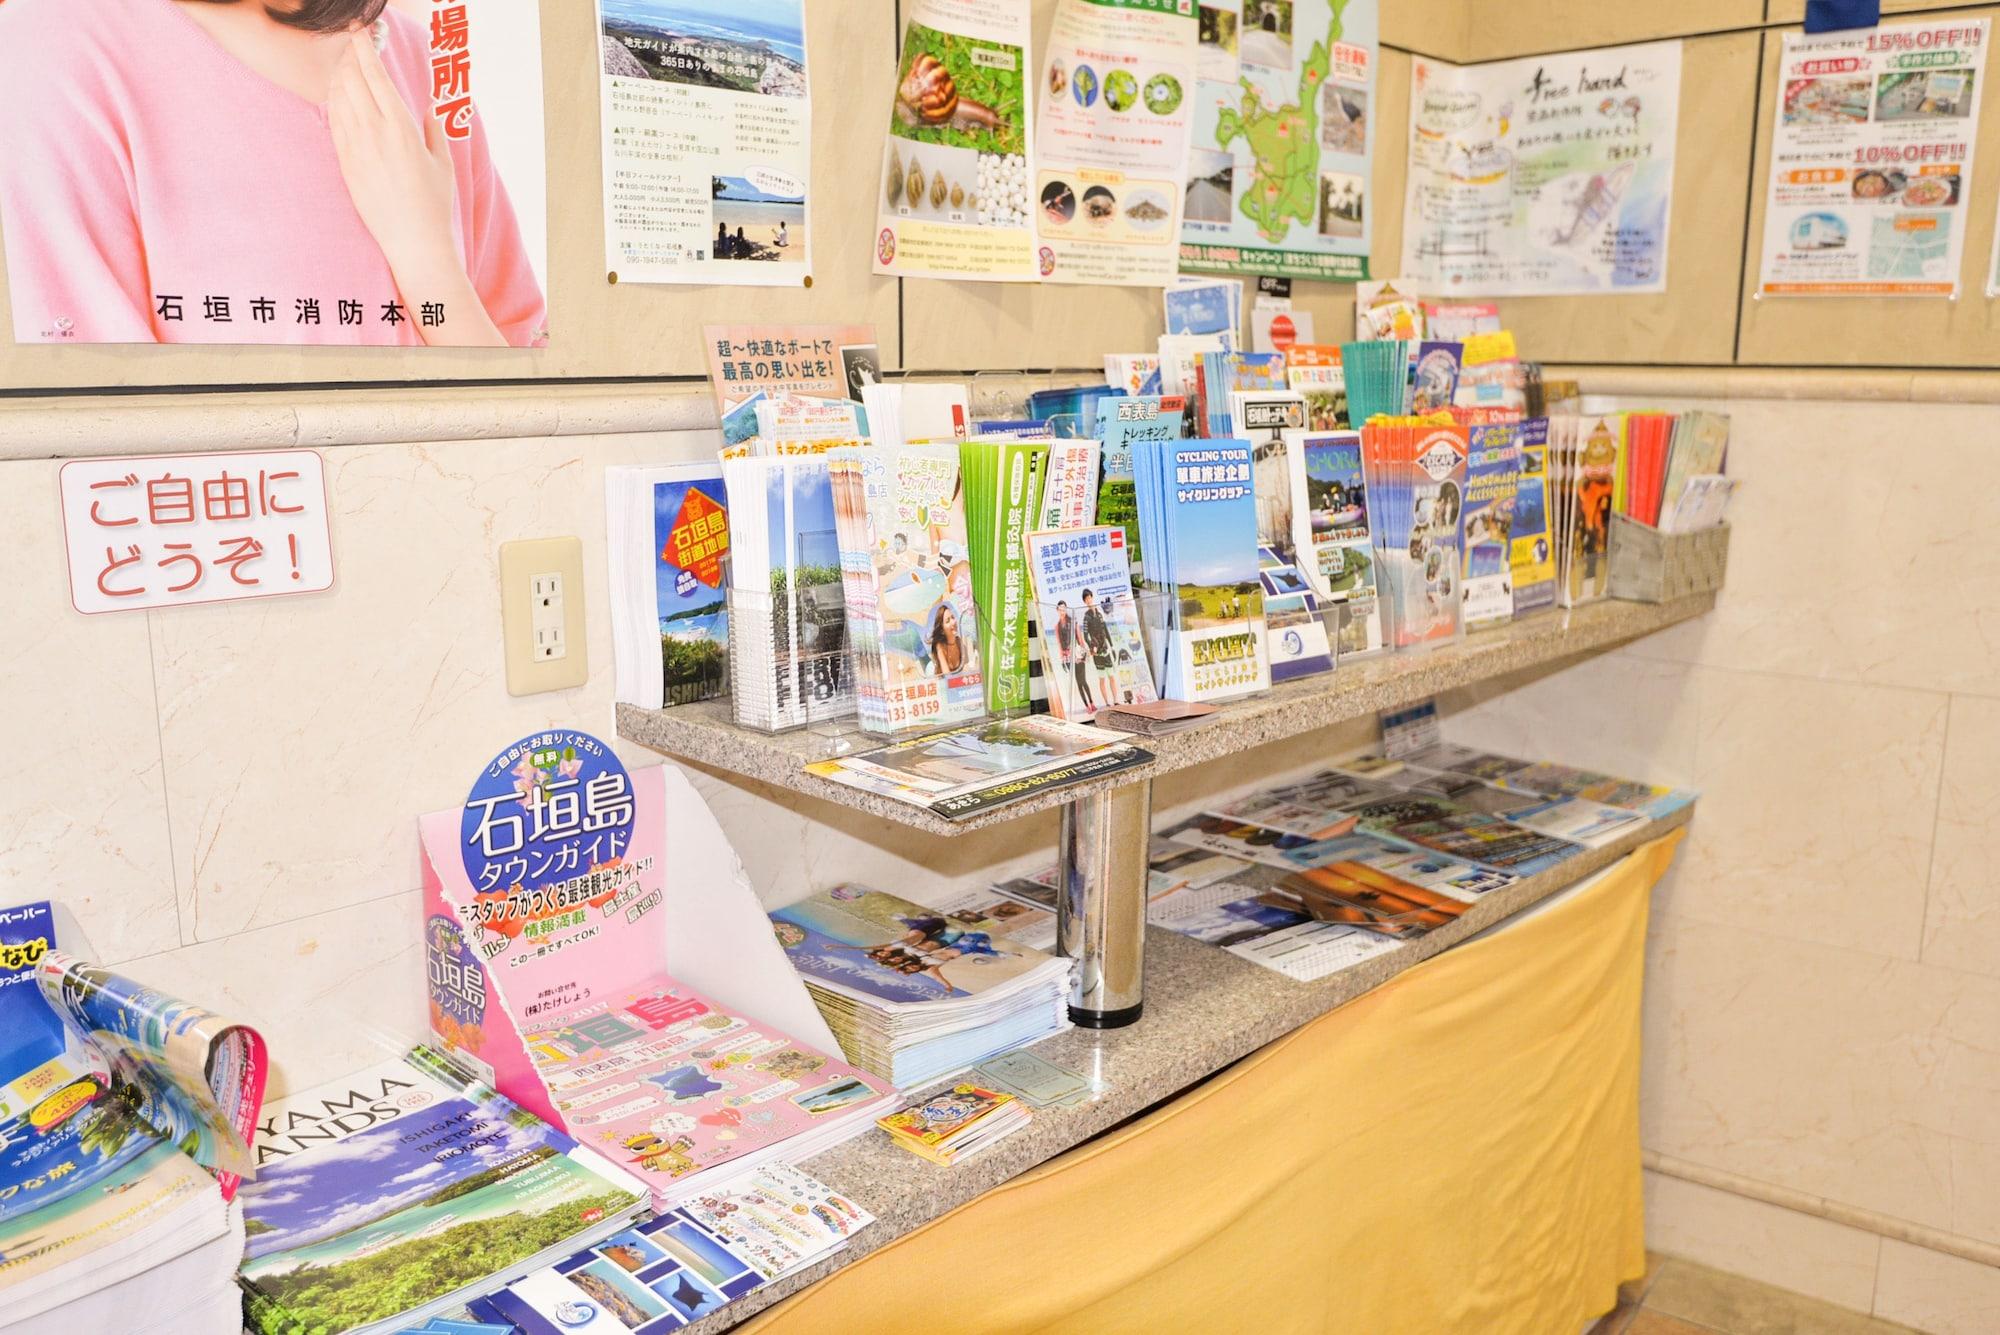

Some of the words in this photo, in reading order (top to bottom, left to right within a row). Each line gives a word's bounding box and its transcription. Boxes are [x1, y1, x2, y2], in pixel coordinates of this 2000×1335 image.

[430, 0, 472, 138] 場所で
[155, 293, 446, 328] 石垣市消防本部
[1117, 401, 1159, 421] 西表島
[1123, 425, 1169, 439] トレッキング
[1176, 450, 1220, 463] CYCLING
[1221, 449, 1249, 461] TOUR
[90, 470, 304, 527] ご自由に
[1177, 486, 1251, 503] サイクリングツアー
[671, 509, 726, 551] 石垣島
[1040, 532, 1107, 559] 海遊びの準備は
[97, 533, 301, 596] どうぞ！
[961, 673, 980, 685] 今なら
[488, 732, 604, 779] ご自由にお取りください
[533, 750, 558, 765] 無料
[465, 770, 634, 858] 石垣島
[478, 830, 628, 893] タウンガイド
[524, 909, 587, 939] 情報満載
[2, 940, 45, 967] なび
[509, 925, 601, 968] この一冊ですべてOK!
[427, 942, 486, 1010] 石垣島
[430, 983, 482, 1025] タウンガイド
[573, 1000, 610, 1020] 2017
[255, 1077, 417, 1138] YAMA
[256, 1100, 402, 1166] ANDS
[399, 1111, 474, 1145] ISHIGAKI
[416, 1121, 489, 1154] TAKETOMI
[432, 1131, 507, 1163] IRIOMOTE
[487, 1148, 532, 1168] KOHAMA
[498, 1153, 542, 1175] HATOMA
